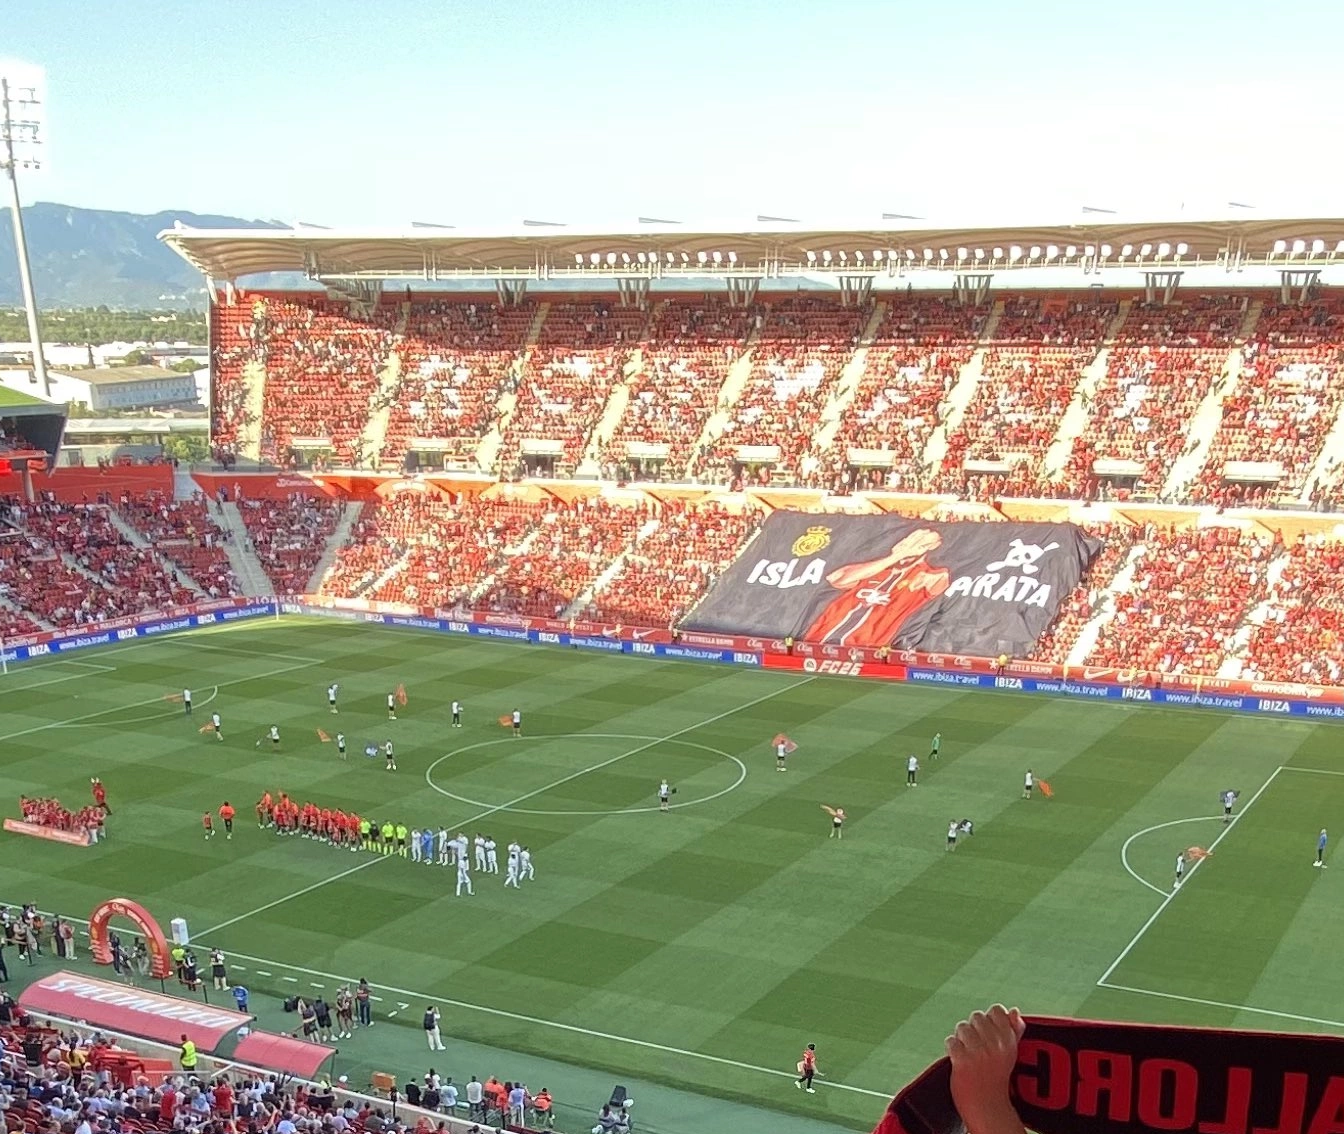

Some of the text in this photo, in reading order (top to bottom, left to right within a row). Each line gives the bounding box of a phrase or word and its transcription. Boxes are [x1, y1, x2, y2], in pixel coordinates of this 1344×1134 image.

[746, 558, 826, 589] ISLA
[944, 573, 1052, 608] PIRATA
[117, 627, 138, 640] IBIZA
[28, 643, 51, 657] IBIZA
[632, 642, 656, 654] IBIZA
[734, 652, 758, 664] IBIZA
[994, 676, 1023, 689] IBIZA
[1122, 687, 1152, 700] IBIZA
[1166, 692, 1243, 708] www.ibiza.travel
[1258, 698, 1291, 712] IBIZA
[38, 977, 245, 1030] SPECIALIZED
